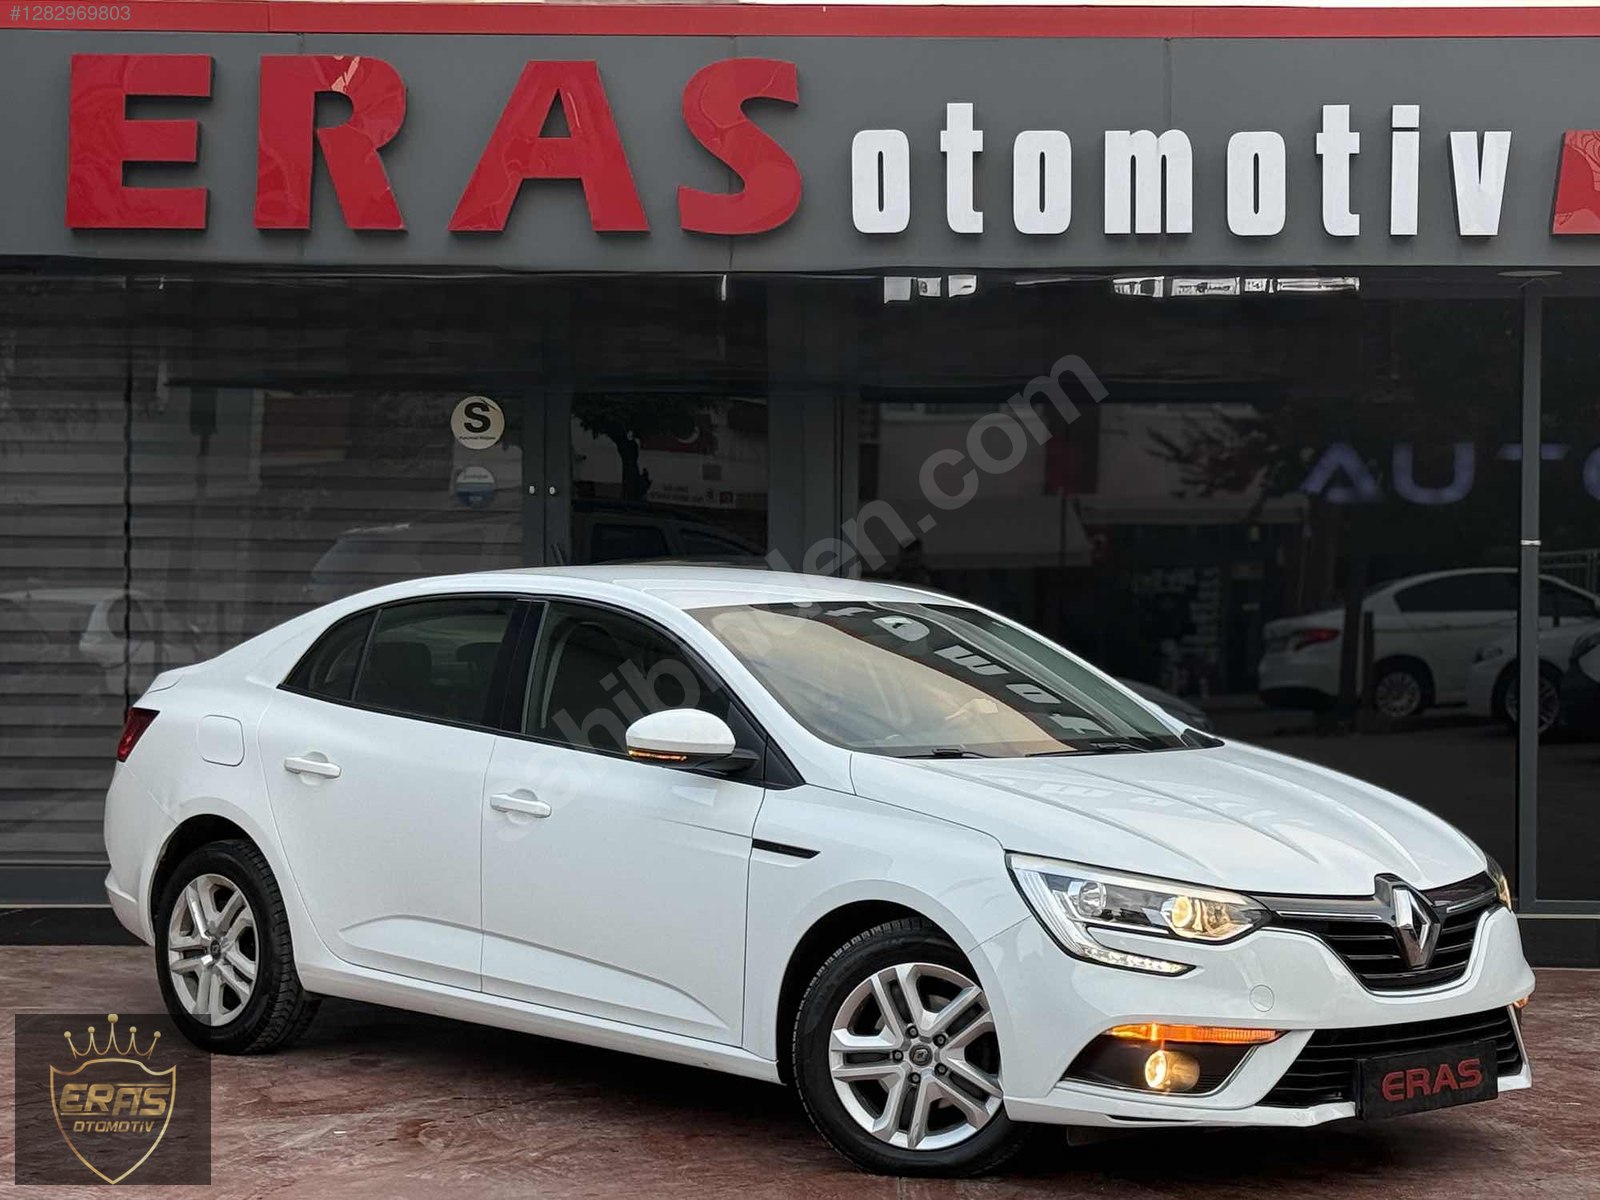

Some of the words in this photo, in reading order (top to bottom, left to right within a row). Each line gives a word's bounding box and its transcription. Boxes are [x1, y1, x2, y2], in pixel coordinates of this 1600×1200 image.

[66, 54, 803, 236] ERAS
[851, 102, 1512, 237] otomotiv
[463, 402, 492, 433] S
[1302, 441, 1600, 505] AUT
[1381, 1058, 1483, 1101] ERAS
